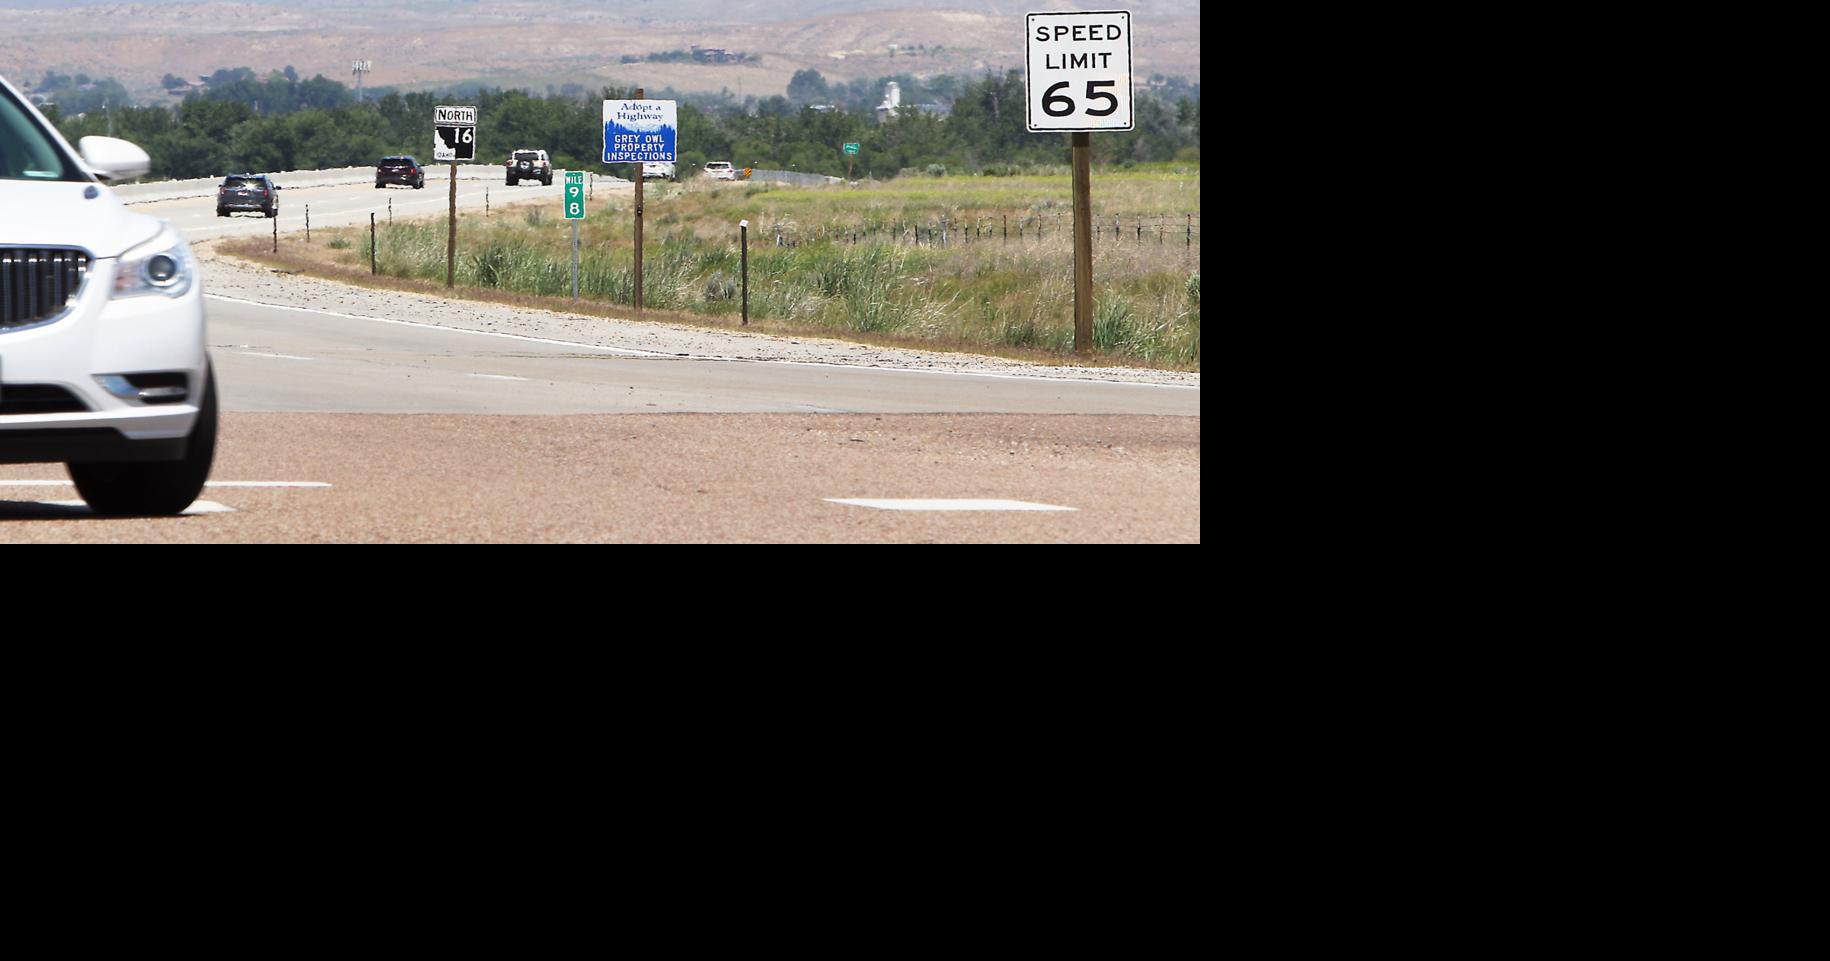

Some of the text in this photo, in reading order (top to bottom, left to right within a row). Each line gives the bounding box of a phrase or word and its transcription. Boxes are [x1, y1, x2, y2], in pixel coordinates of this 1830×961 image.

[1035, 24, 1122, 42] SPEED
[1046, 52, 1112, 70] LIMIT
[1041, 80, 1119, 117] 65
[621, 103, 653, 112] Adopt
[438, 109, 473, 121] NORTH
[616, 112, 663, 121] Highway
[454, 127, 473, 144] 16
[614, 134, 665, 143] GREY OWL
[614, 143, 665, 152] PROPERTY
[607, 152, 673, 161] INSPECTIONS
[565, 175, 583, 185] MILE
[569, 186, 579, 198] 9
[569, 202, 580, 215] 8
